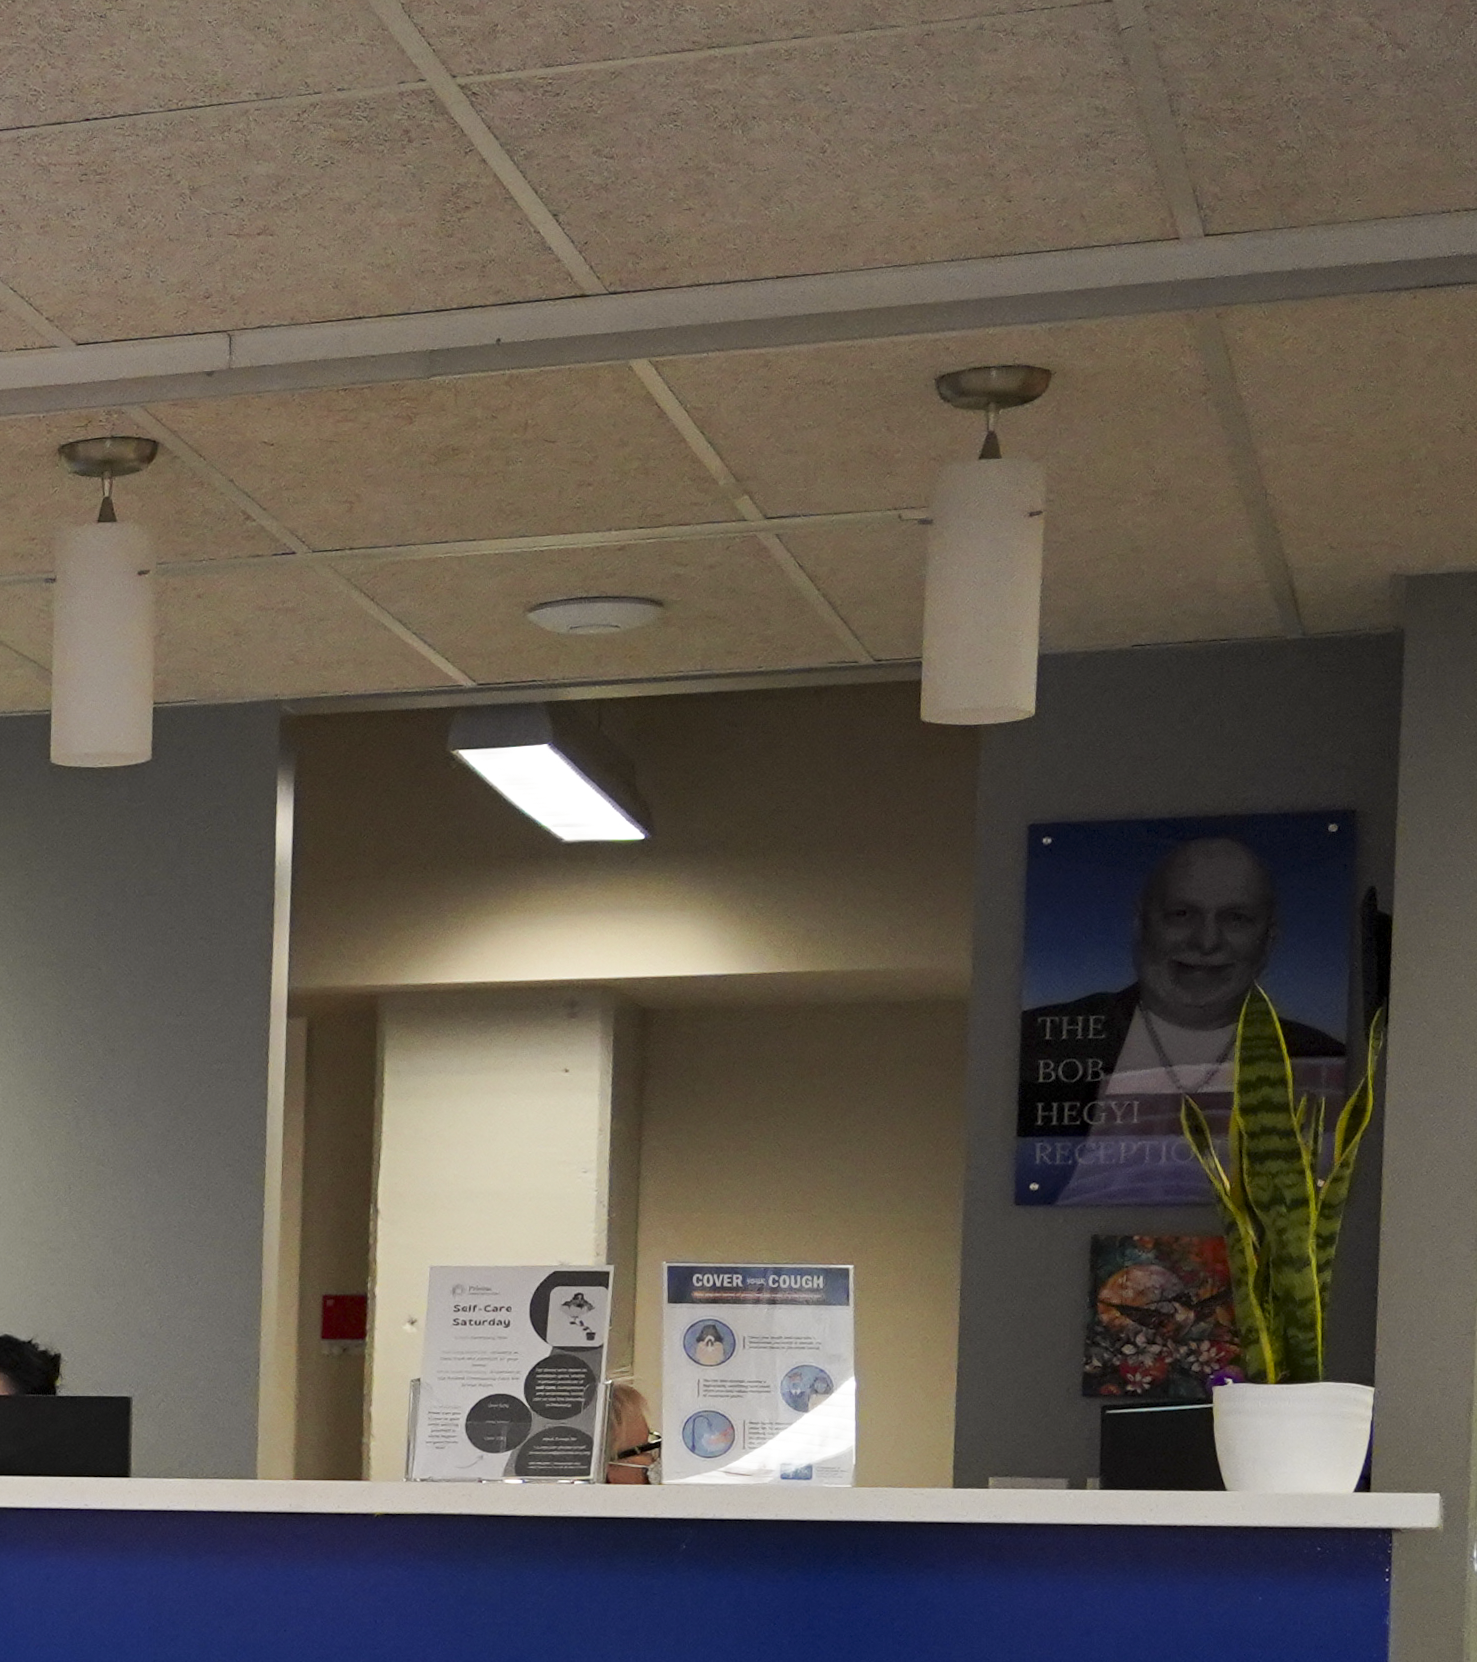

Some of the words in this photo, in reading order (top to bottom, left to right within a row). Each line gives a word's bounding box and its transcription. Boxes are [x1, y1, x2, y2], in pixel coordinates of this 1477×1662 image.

[1037, 1015, 1106, 1040] THE
[1037, 1058, 1106, 1083] BOB
[1034, 1100, 1140, 1126] HEGYI
[1034, 1140, 1221, 1166] RECEPTIO
[692, 1273, 743, 1288] COVER
[768, 1274, 825, 1289] COUGH
[452, 1304, 513, 1313] Self-Care
[452, 1317, 511, 1328] Saturday
